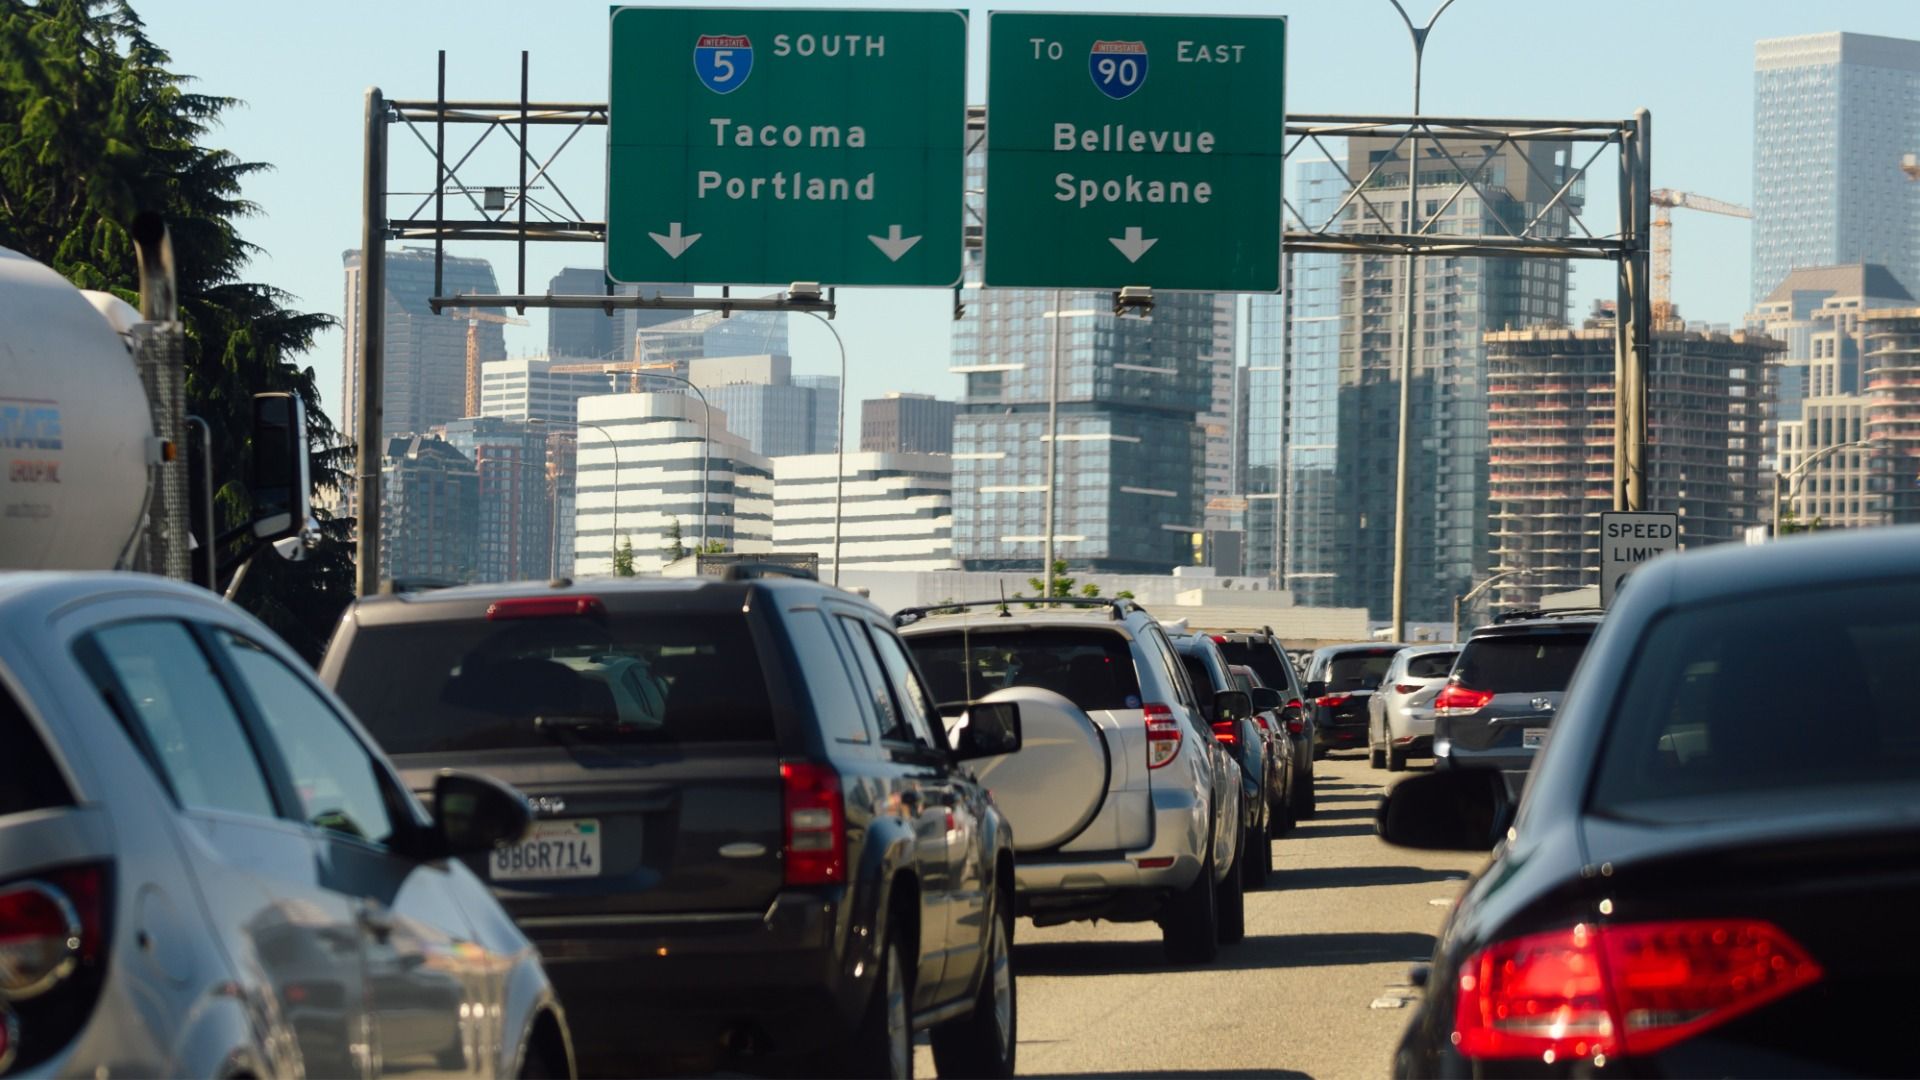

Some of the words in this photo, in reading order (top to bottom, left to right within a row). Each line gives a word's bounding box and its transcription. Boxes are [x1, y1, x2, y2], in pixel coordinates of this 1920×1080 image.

[703, 39, 744, 47] INTERSTATE
[773, 34, 886, 57] SOUTH
[713, 50, 735, 82] 5
[1098, 58, 1138, 86] 90
[709, 118, 866, 148] Tacoma
[1053, 123, 1216, 153] Bellevue
[698, 170, 876, 200] Portland
[1054, 172, 1213, 209] Spokane
[1607, 523, 1672, 539] SPEED
[496, 841, 593, 870] 8BGR714
